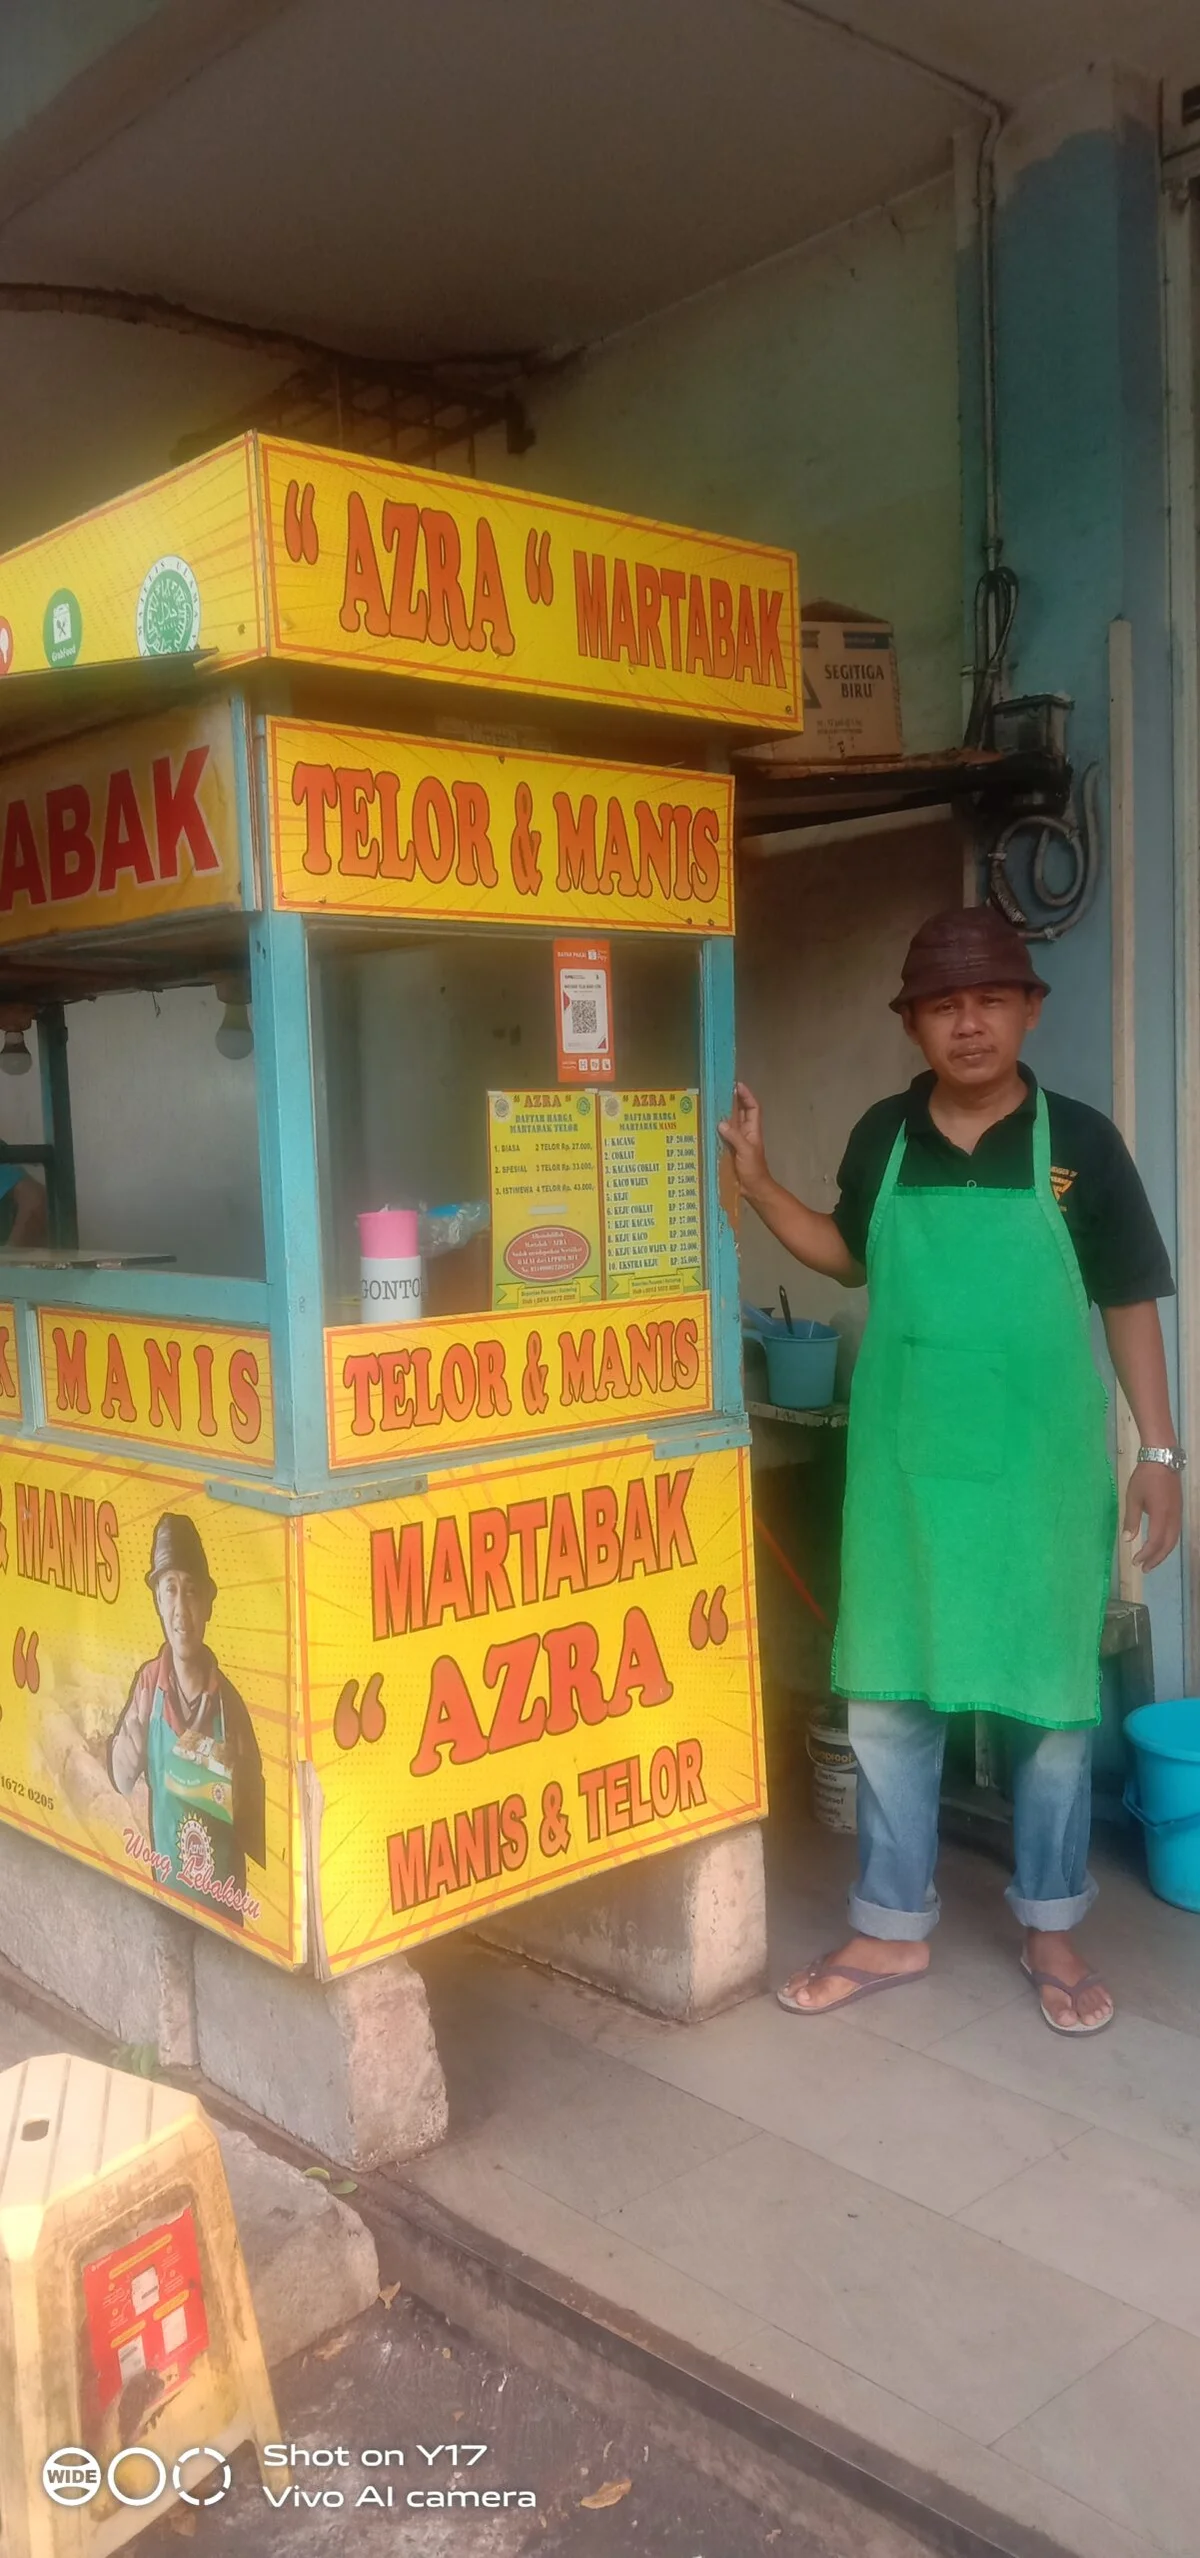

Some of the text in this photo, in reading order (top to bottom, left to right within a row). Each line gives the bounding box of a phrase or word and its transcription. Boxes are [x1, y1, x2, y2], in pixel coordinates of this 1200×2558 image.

[340, 491, 516, 656] AZRA
[572, 549, 788, 690] MARTABAK
[51, 645, 76, 662] GrabFood
[824, 664, 884, 680] SEGITIGA
[841, 683, 873, 698] BIRU
[291, 760, 721, 903] TELOR & MANIS
[524, 1095, 562, 1108] AZRA
[632, 1094, 666, 1107] AZRA
[660, 1122, 677, 1130] MANIS
[612, 1137, 635, 1146] KACANG
[612, 1151, 634, 1159] COKLAT
[613, 1164, 636, 1174] KACANG
[637, 1163, 659, 1172] COKLAT
[614, 1192, 628, 1201] KEJU
[614, 1206, 629, 1215] KEJU
[631, 1205, 653, 1214] COKLAT
[615, 1219, 629, 1229] KEJU
[631, 1218, 655, 1228] KACANG
[615, 1234, 629, 1242] KEJU
[632, 1232, 648, 1241] KACO
[615, 1248, 630, 1256] KEJU
[632, 1246, 648, 1255] KACO
[619, 1260, 642, 1270] EKSTRA
[644, 1259, 658, 1268] KEJU
[343, 1318, 700, 1436] TELOR & MANIS
[52, 1327, 262, 1444] MANIS
[15, 1481, 121, 1604] MANIS
[370, 1469, 696, 1641] MARTABAK
[409, 1605, 675, 1778] AZRA
[28, 1787, 54, 1811] 0205
[386, 1738, 707, 1915] MANIS & TELOR
[123, 1827, 172, 1880] Wong
[176, 1854, 261, 1919] Lebaksiu
